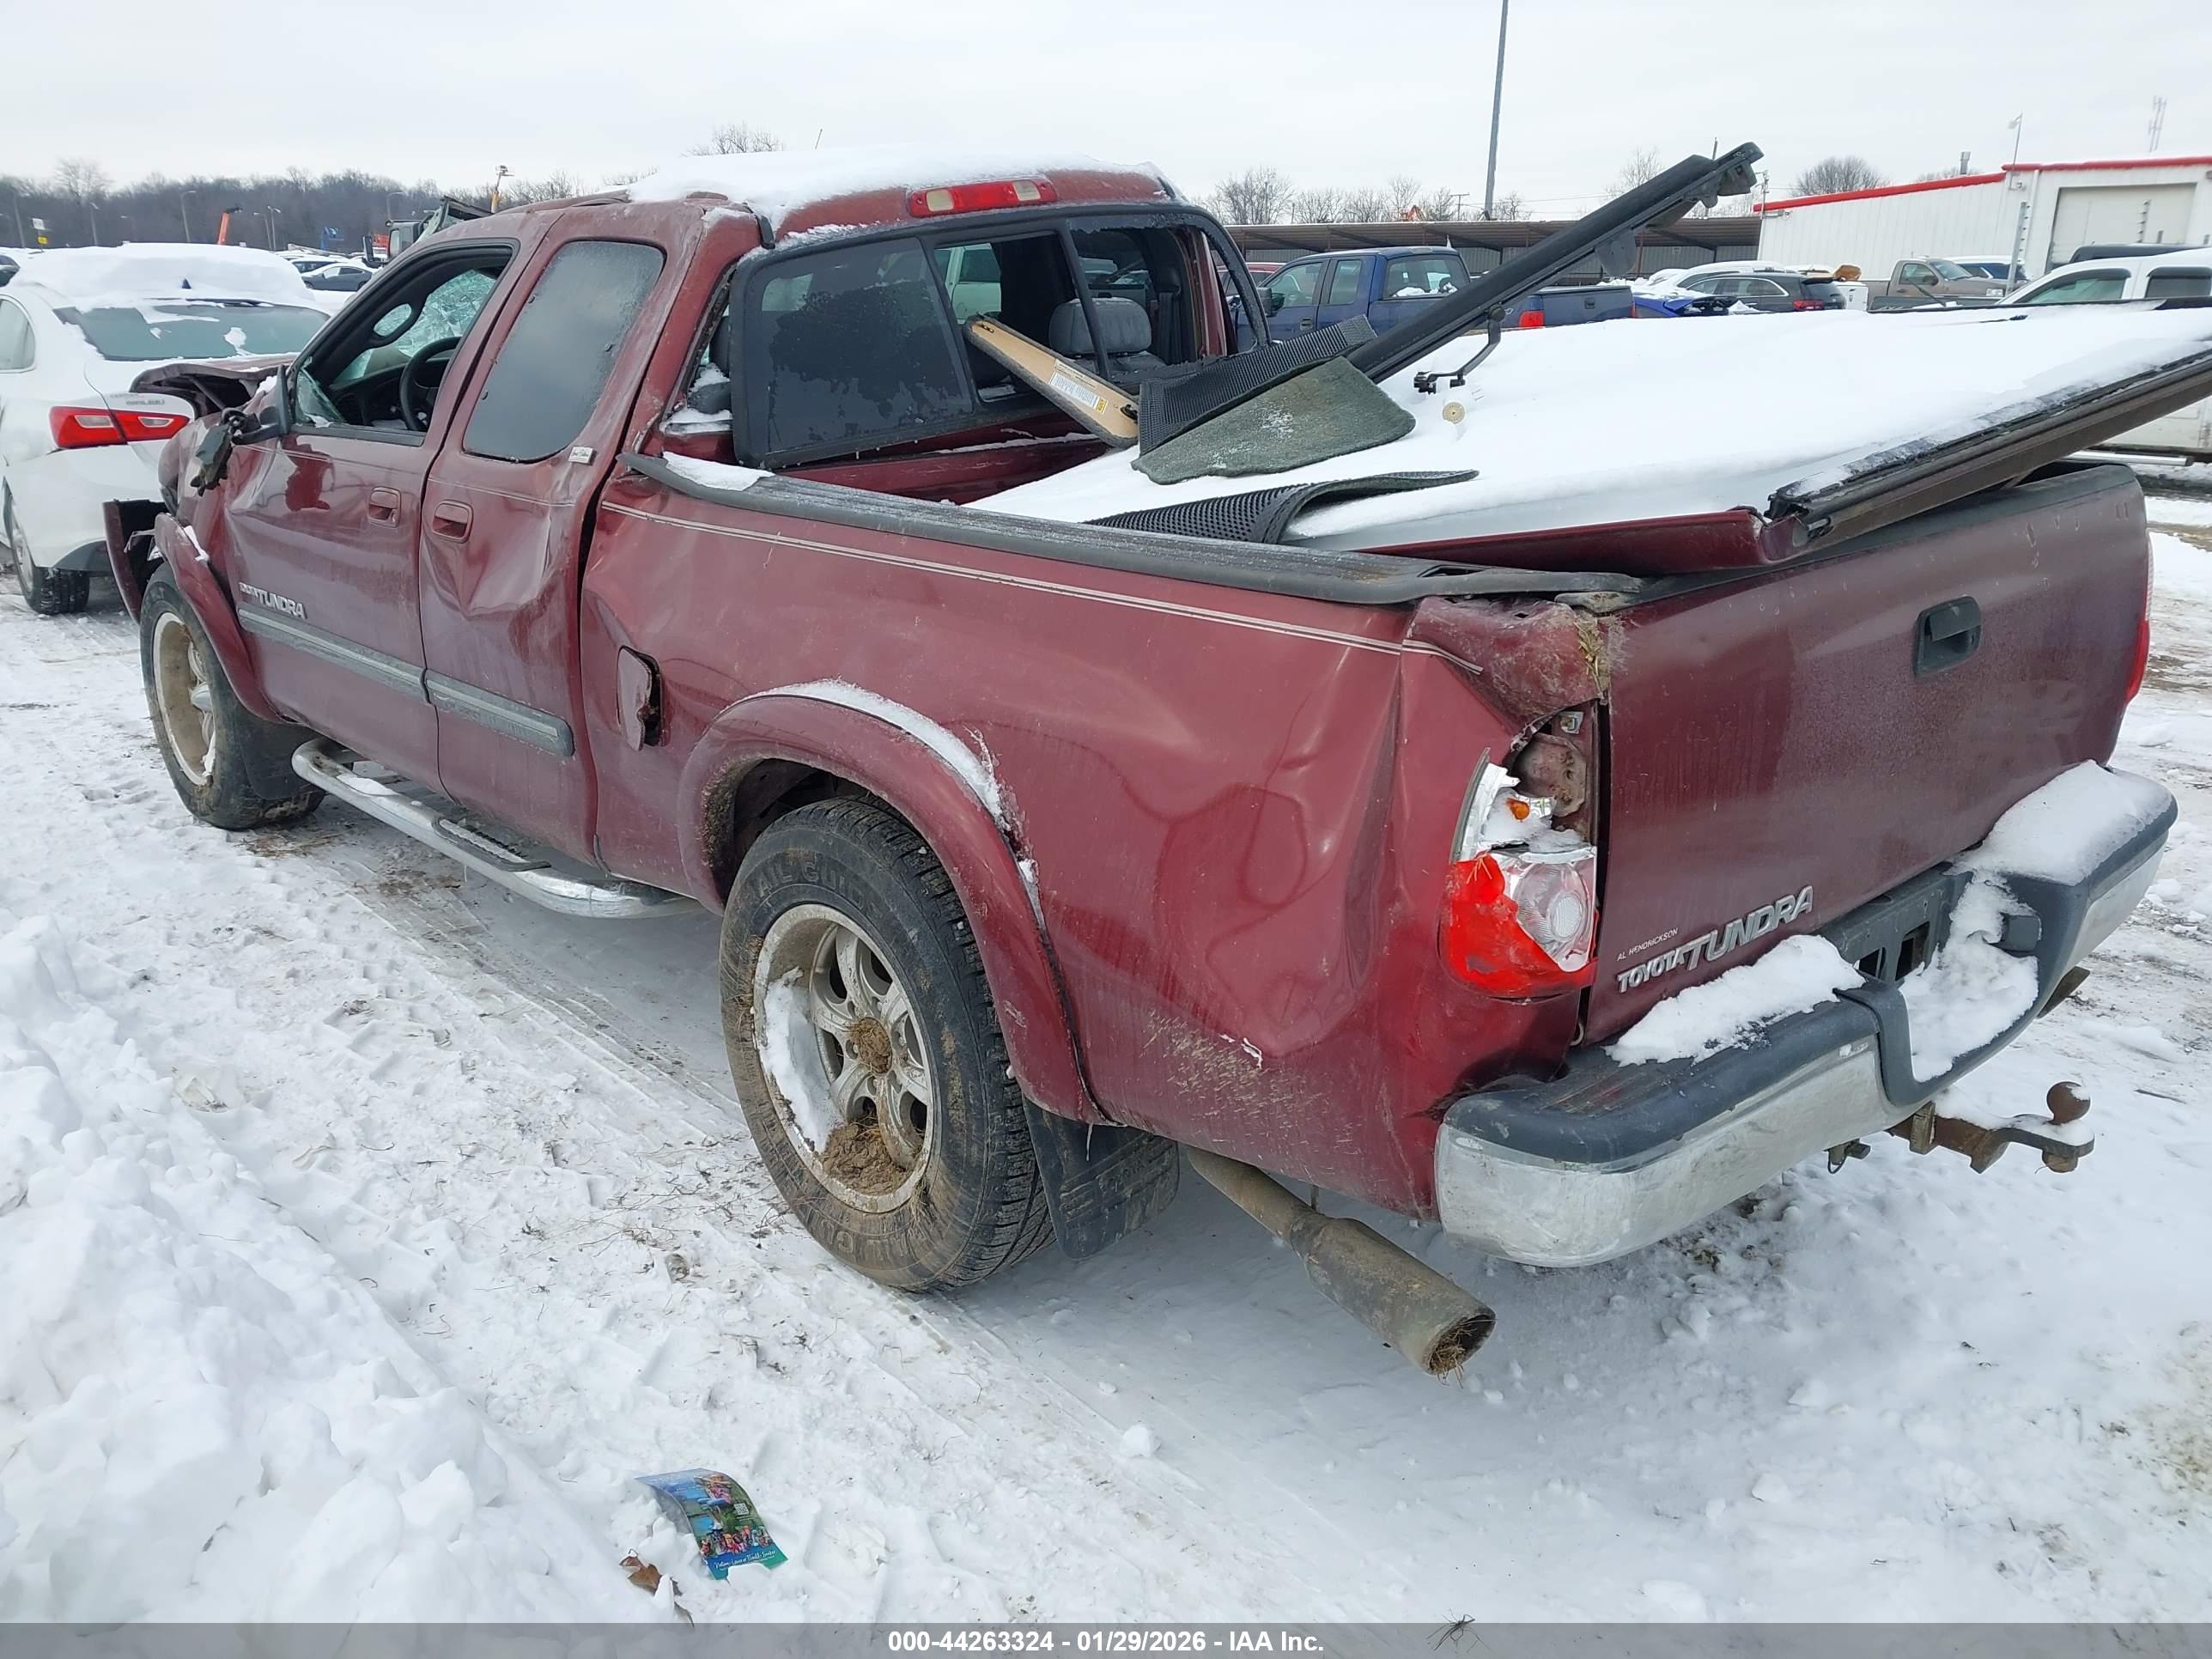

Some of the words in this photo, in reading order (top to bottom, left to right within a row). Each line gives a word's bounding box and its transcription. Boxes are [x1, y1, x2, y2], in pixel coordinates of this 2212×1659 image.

[257, 588, 306, 620] TUNDRA
[1616, 948, 1686, 994] TOYOTA
[1682, 884, 1814, 972] TUNDRA
[1616, 951, 1627, 962] AL
[1628, 927, 1679, 956] HENDRICKSON
